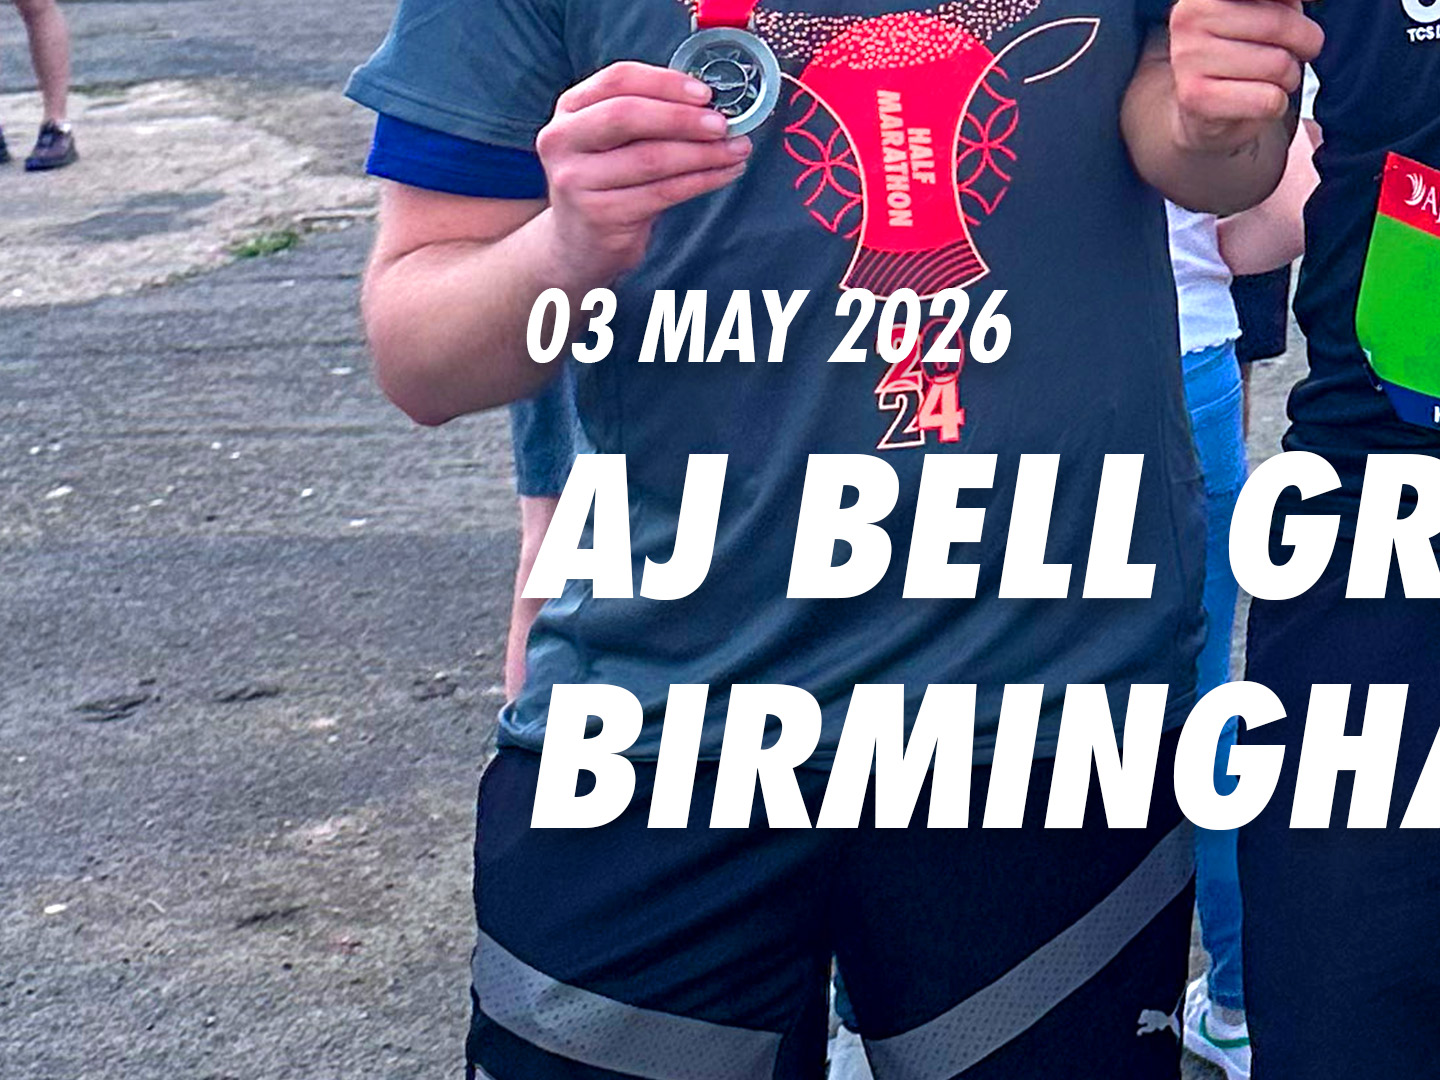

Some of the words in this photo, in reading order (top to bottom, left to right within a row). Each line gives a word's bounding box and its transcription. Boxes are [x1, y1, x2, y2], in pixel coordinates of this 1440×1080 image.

[1406, 24, 1435, 42] TCS
[876, 89, 913, 227] MARATHON
[907, 127, 936, 185] HALF
[877, 379, 966, 450] 24
